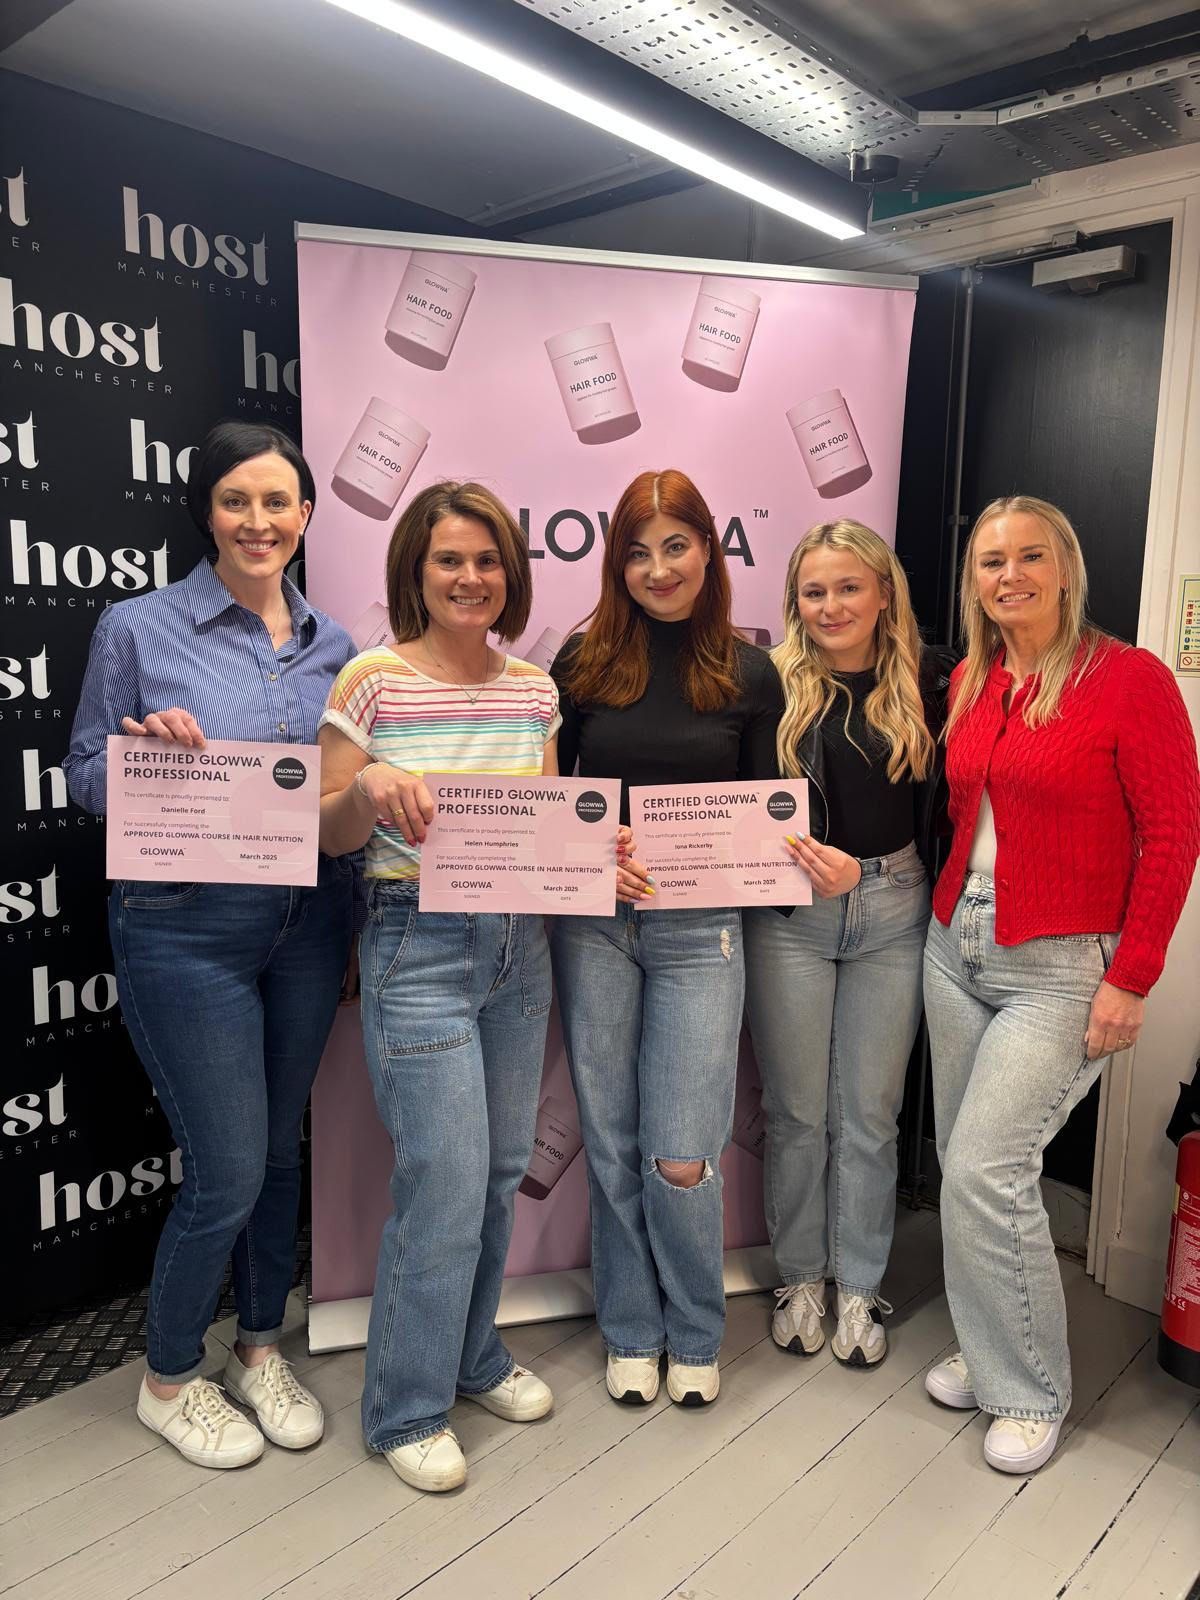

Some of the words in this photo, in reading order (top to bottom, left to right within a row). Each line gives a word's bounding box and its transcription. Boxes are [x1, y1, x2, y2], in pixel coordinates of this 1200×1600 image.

[123, 186, 270, 286] host
[117, 261, 280, 307] MANCHESTER
[406, 293, 428, 308] HAIR
[428, 303, 452, 320] FOOD
[0, 276, 164, 373] host
[698, 322, 718, 336] HAIR
[720, 330, 741, 344] FOOD
[13, 359, 173, 395] ANCHESTER
[570, 380, 592, 394] HAIR
[592, 372, 617, 386] FOOD
[808, 442, 828, 456] HAIR
[828, 432, 848, 446] FOOD
[357, 442, 378, 460] HAIR
[378, 455, 402, 473] FOOD
[519, 507, 755, 567] LOA
[10, 519, 170, 591] host
[5, 595, 112, 609] MANCHE
[0, 643, 52, 700] st
[124, 752, 194, 764] CERTIFIED
[200, 755, 262, 768] GLOWWA
[124, 768, 230, 782] PROFESSIONAL
[438, 788, 504, 799] CERTIFIED
[508, 790, 566, 802] GLOWWA
[643, 796, 701, 808] CERTIFIED
[704, 794, 758, 806] GLOWWA
[161, 806, 188, 814] Danielle
[438, 804, 536, 816] PROFESSIONAL
[644, 810, 732, 822] PROFESSIONAL
[124, 830, 164, 838] APPROVED
[134, 820, 168, 828] successfully
[168, 822, 199, 830] completing
[140, 848, 184, 856] GLOWWA
[446, 854, 476, 862] successfully
[475, 864, 507, 872] GLOWWA
[565, 866, 603, 874] NUTRITION
[0, 864, 61, 923] st
[451, 880, 492, 888] GLOWWA
[660, 880, 698, 888] GLOWWA
[33, 965, 118, 1025] ho
[2, 1072, 69, 1136] st
[534, 1138, 546, 1149] AIR
[545, 1145, 565, 1160] FOOD
[39, 1146, 184, 1231] host
